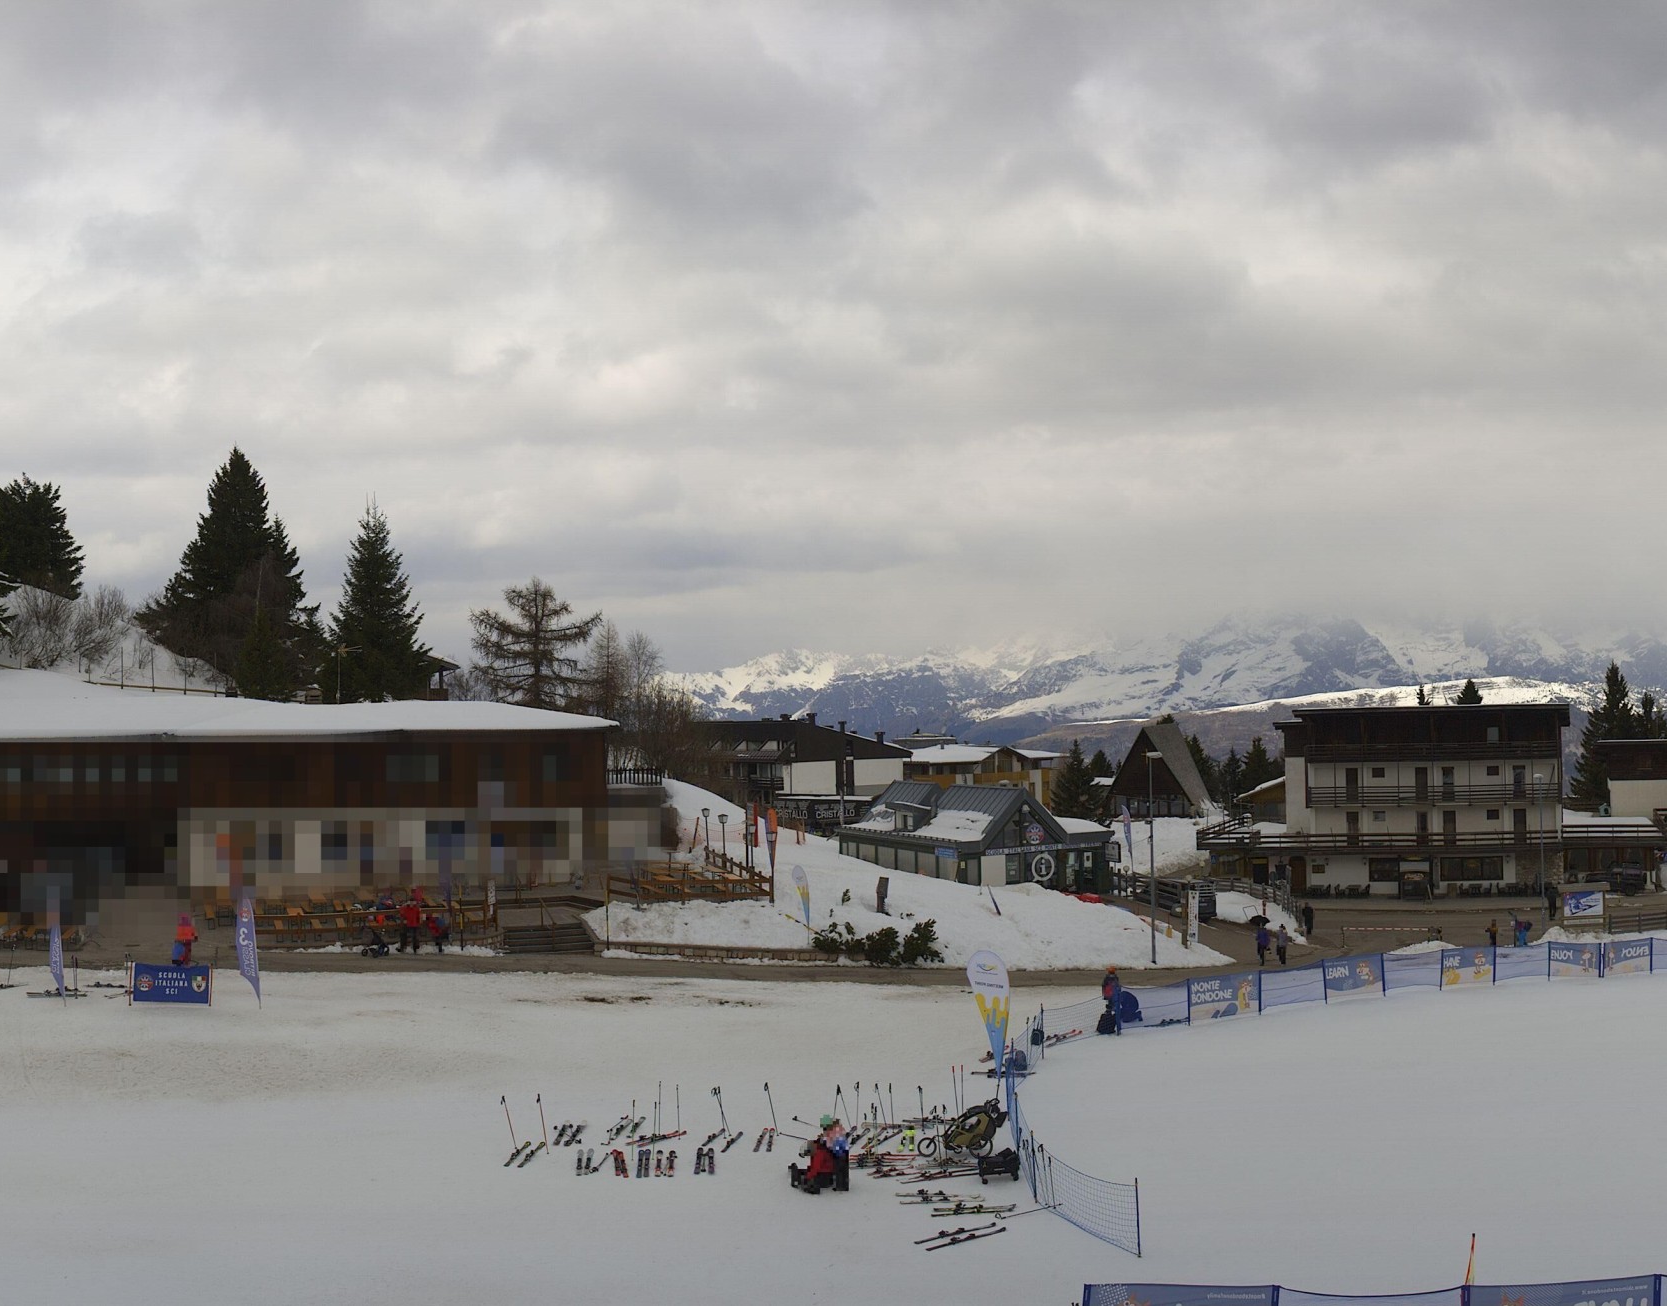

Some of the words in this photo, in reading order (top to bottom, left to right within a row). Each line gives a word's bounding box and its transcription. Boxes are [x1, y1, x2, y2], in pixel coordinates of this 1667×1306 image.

[816, 809, 855, 819] CRISTALO
[1443, 955, 1461, 967] HAVE
[1551, 949, 1573, 961] ENJOY
[1326, 965, 1349, 979] LEARN
[1191, 980, 1221, 992] MONTE
[1191, 989, 1233, 1003] BONDONE
